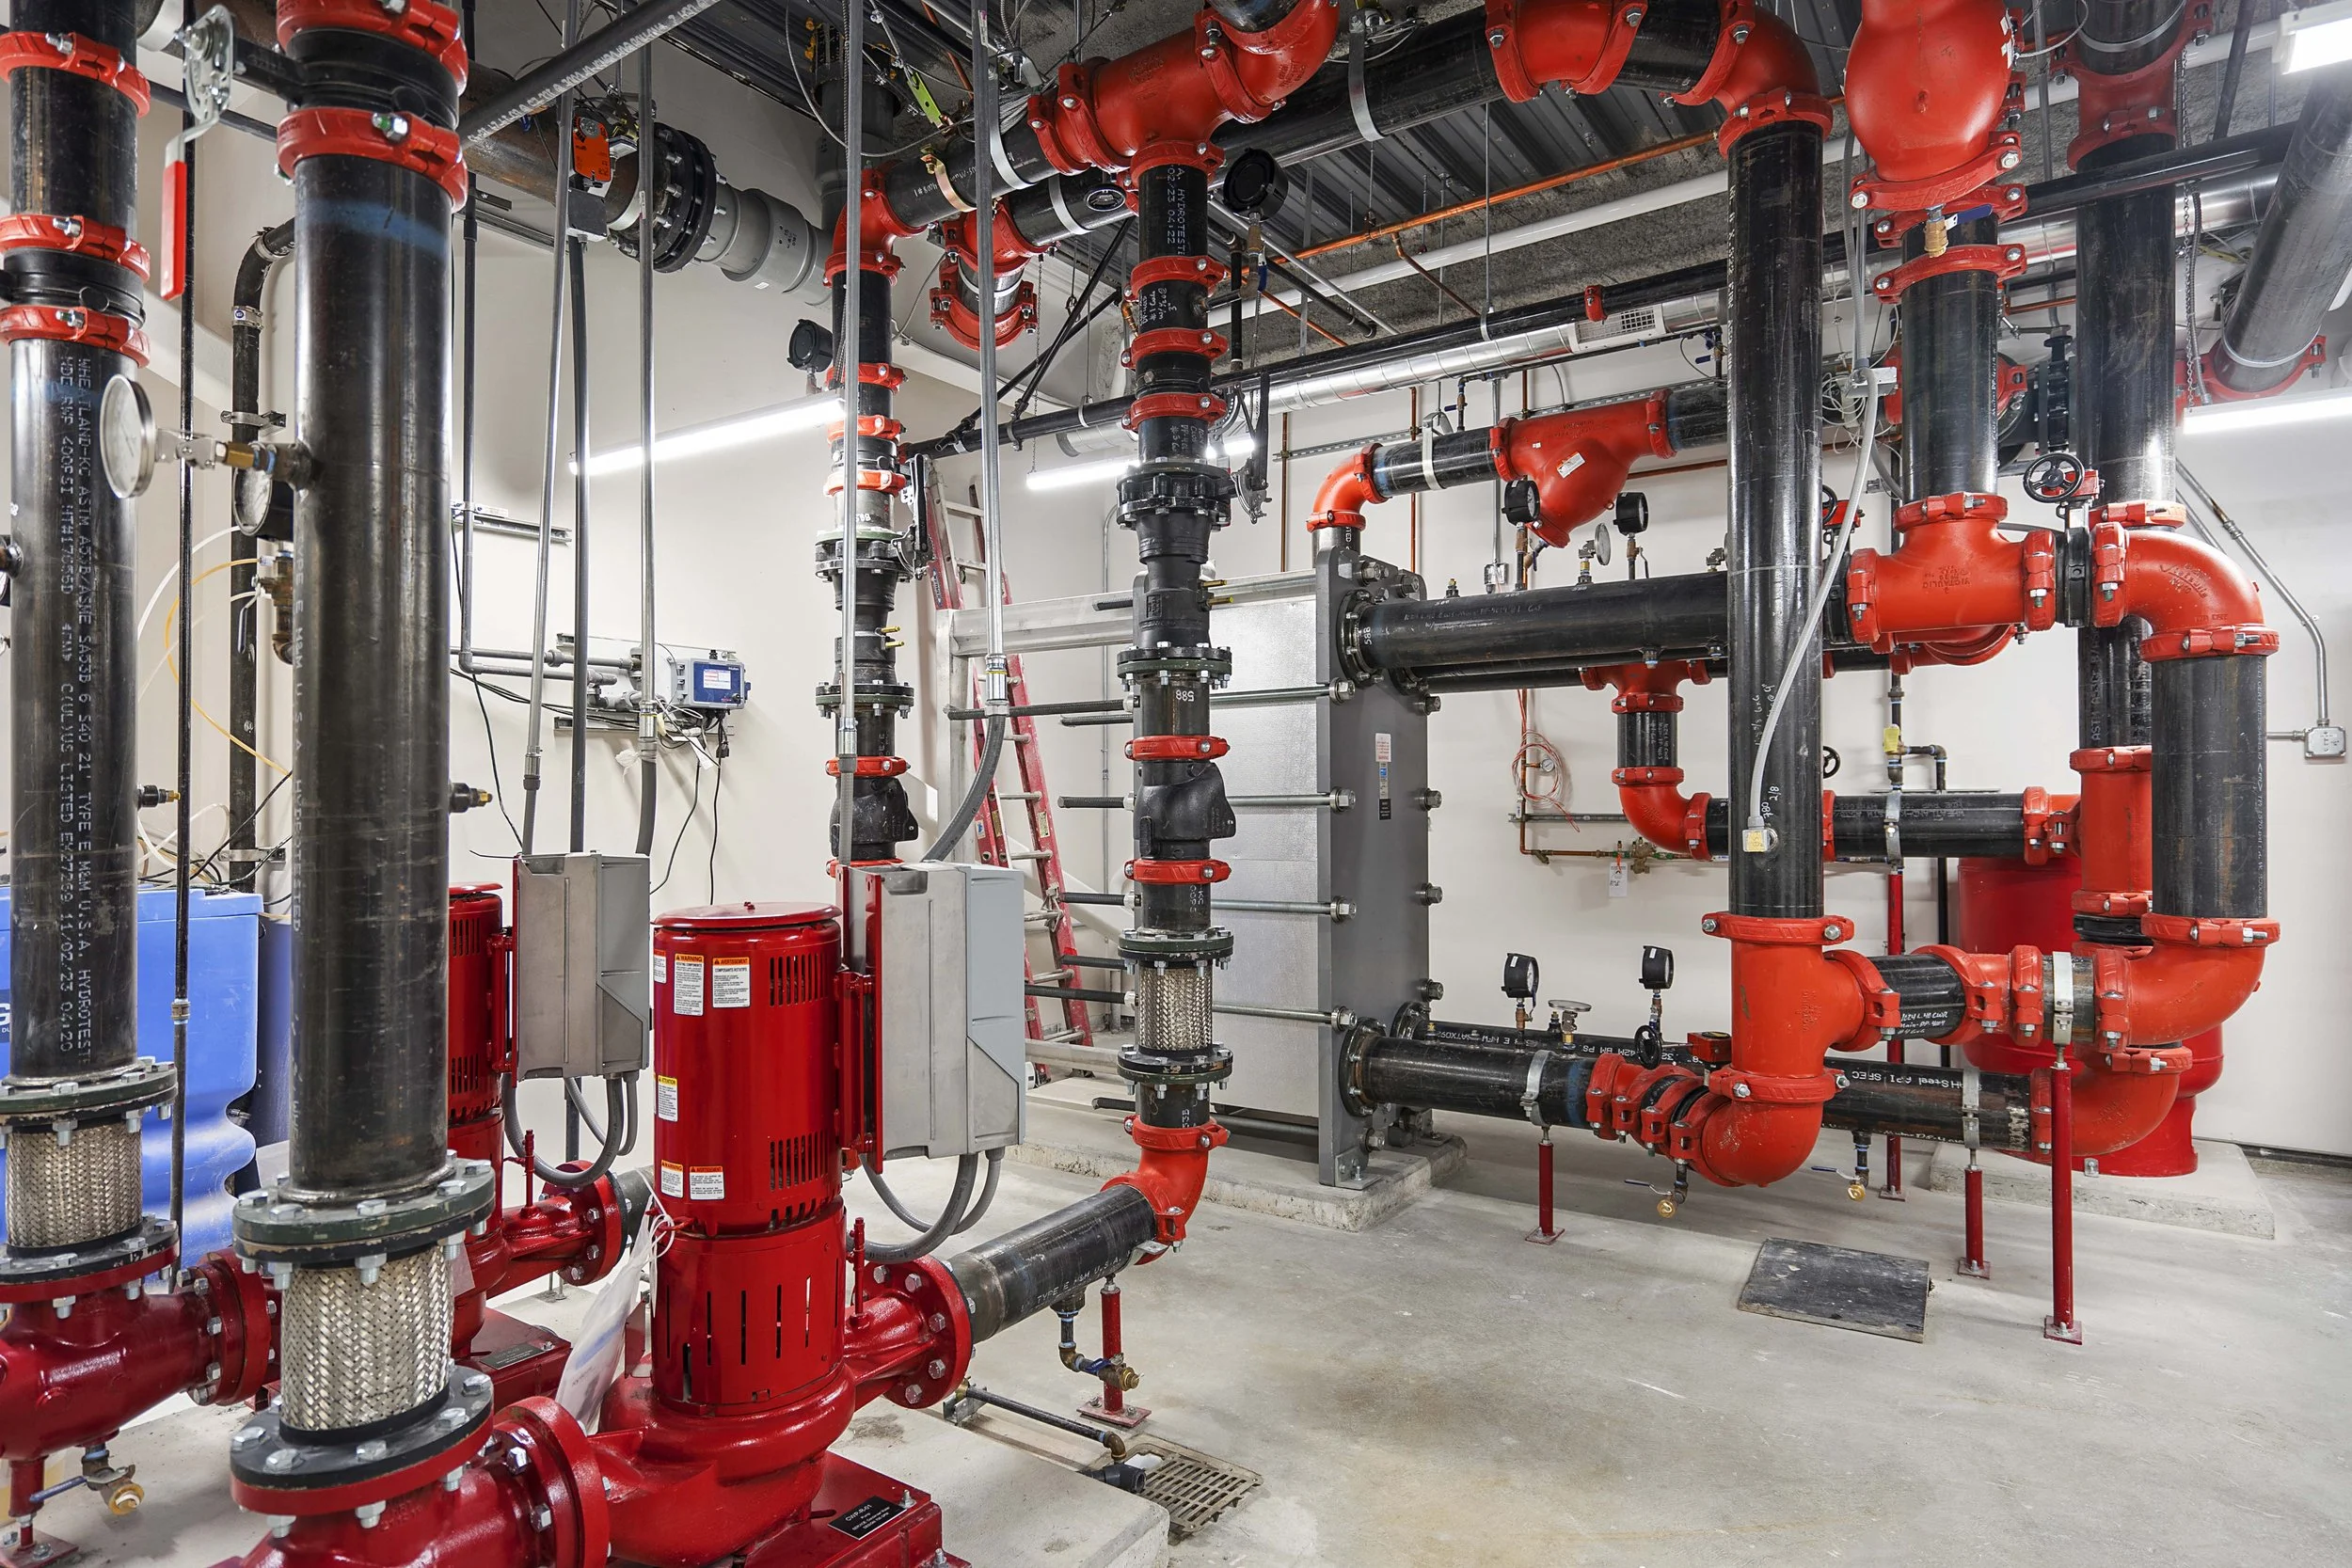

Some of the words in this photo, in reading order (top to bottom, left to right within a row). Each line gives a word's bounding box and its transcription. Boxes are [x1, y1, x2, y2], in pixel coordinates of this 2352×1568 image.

[79, 486, 91, 526] ASTM
[1364, 627, 1373, 645] 588
[79, 635, 91, 683] SA53B
[79, 693, 91, 703] 6
[1176, 689, 1195, 702] 588
[61, 763, 73, 823] LISTED
[79, 792, 91, 831] TYPE
[79, 841, 91, 851] E
[79, 861, 91, 892] M&M
[78, 900, 91, 957] U.S.A.
[1918, 1077, 1950, 1088] Steel
[1037, 1286, 1060, 1304] TYPE
[1064, 1281, 1071, 1290] E
